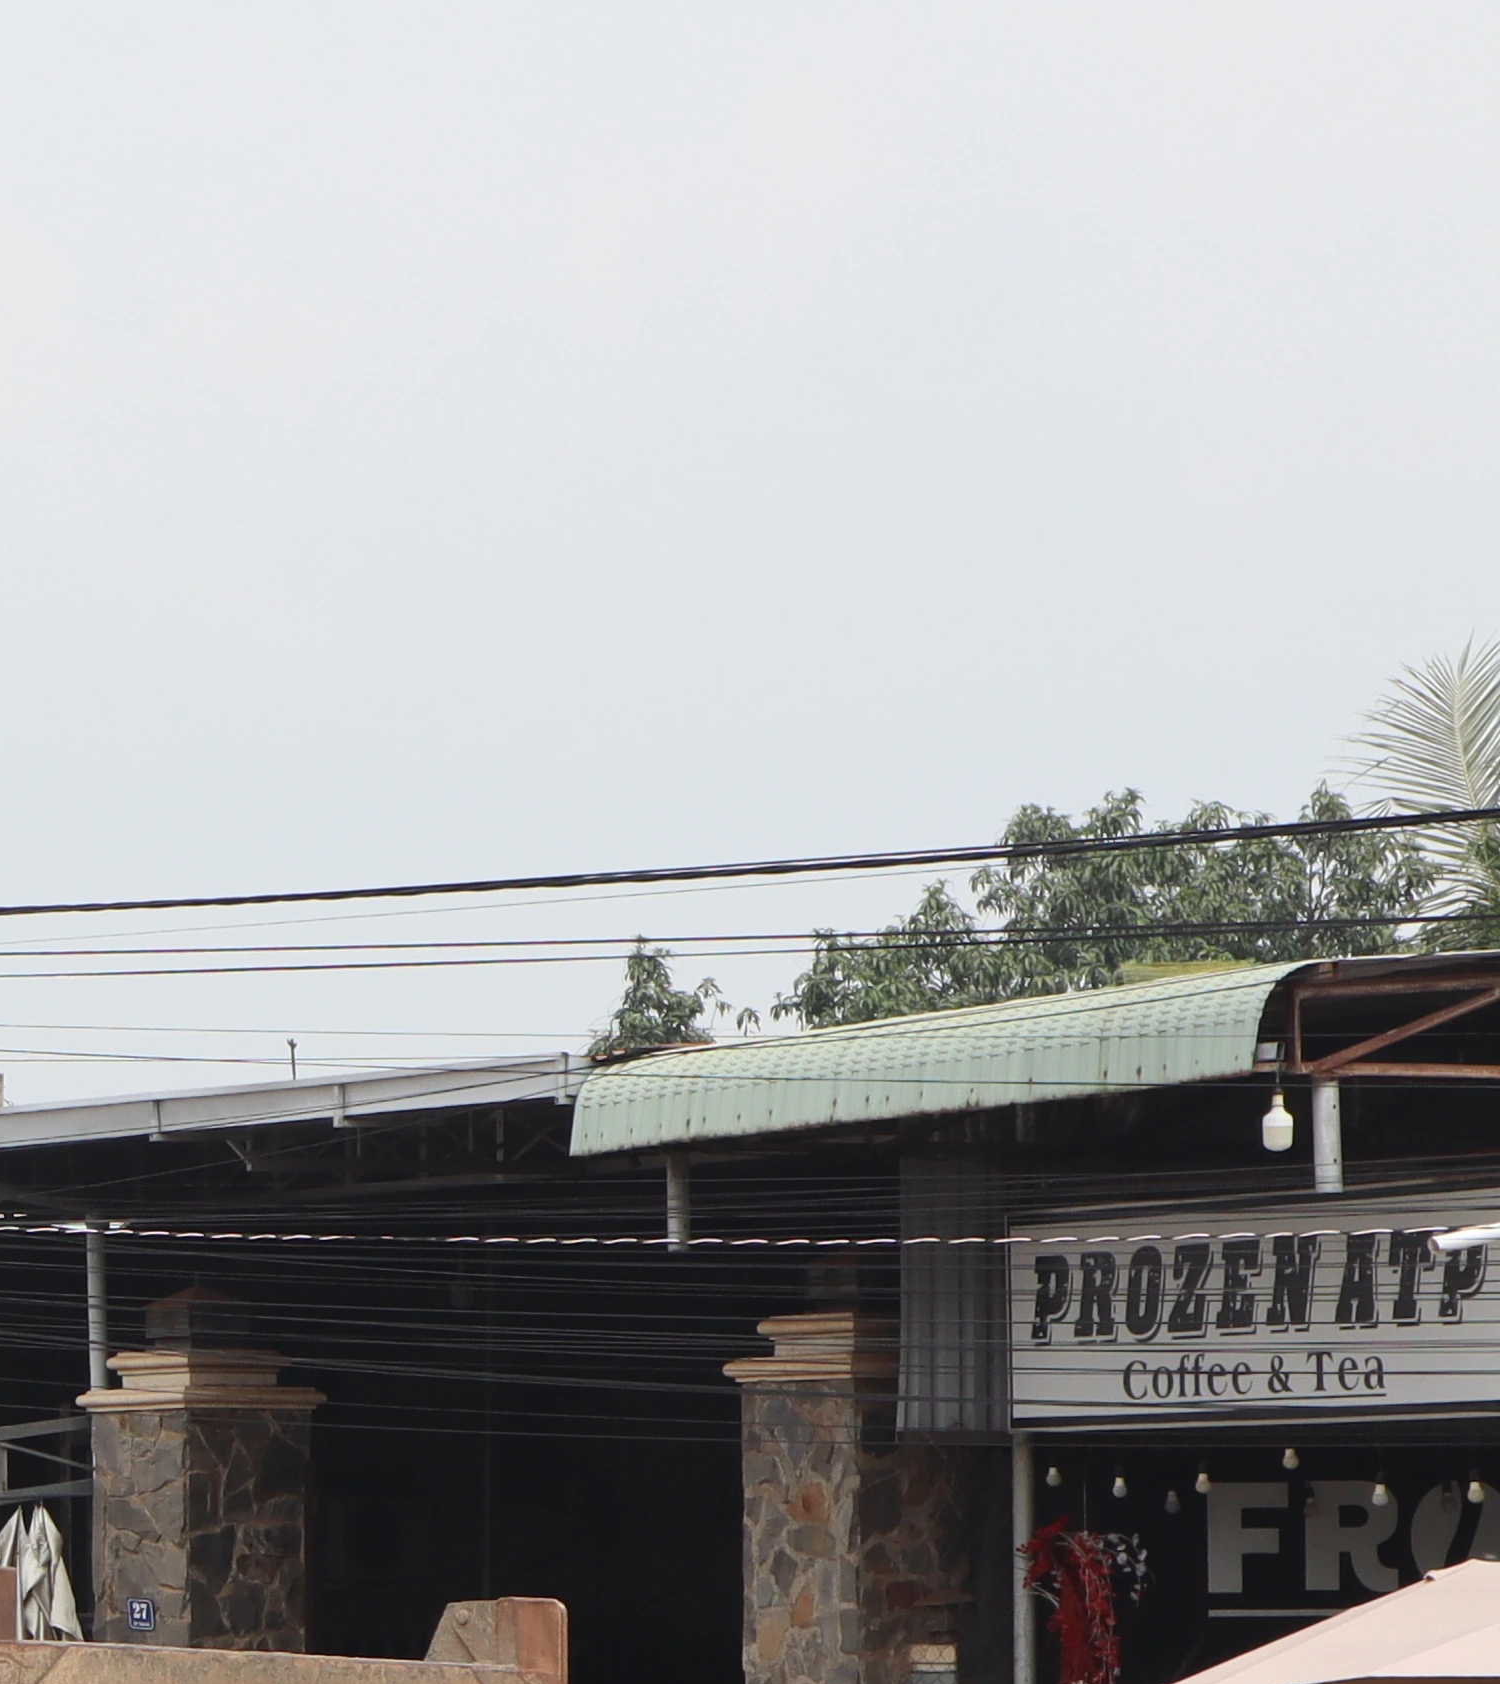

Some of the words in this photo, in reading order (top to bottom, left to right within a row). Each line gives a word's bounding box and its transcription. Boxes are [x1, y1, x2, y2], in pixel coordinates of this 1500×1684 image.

[1031, 1233, 1322, 1345] PROZEN
[1123, 1353, 1253, 1400] Coffee
[1306, 1351, 1386, 1392] Tea
[132, 1602, 148, 1619] 27
